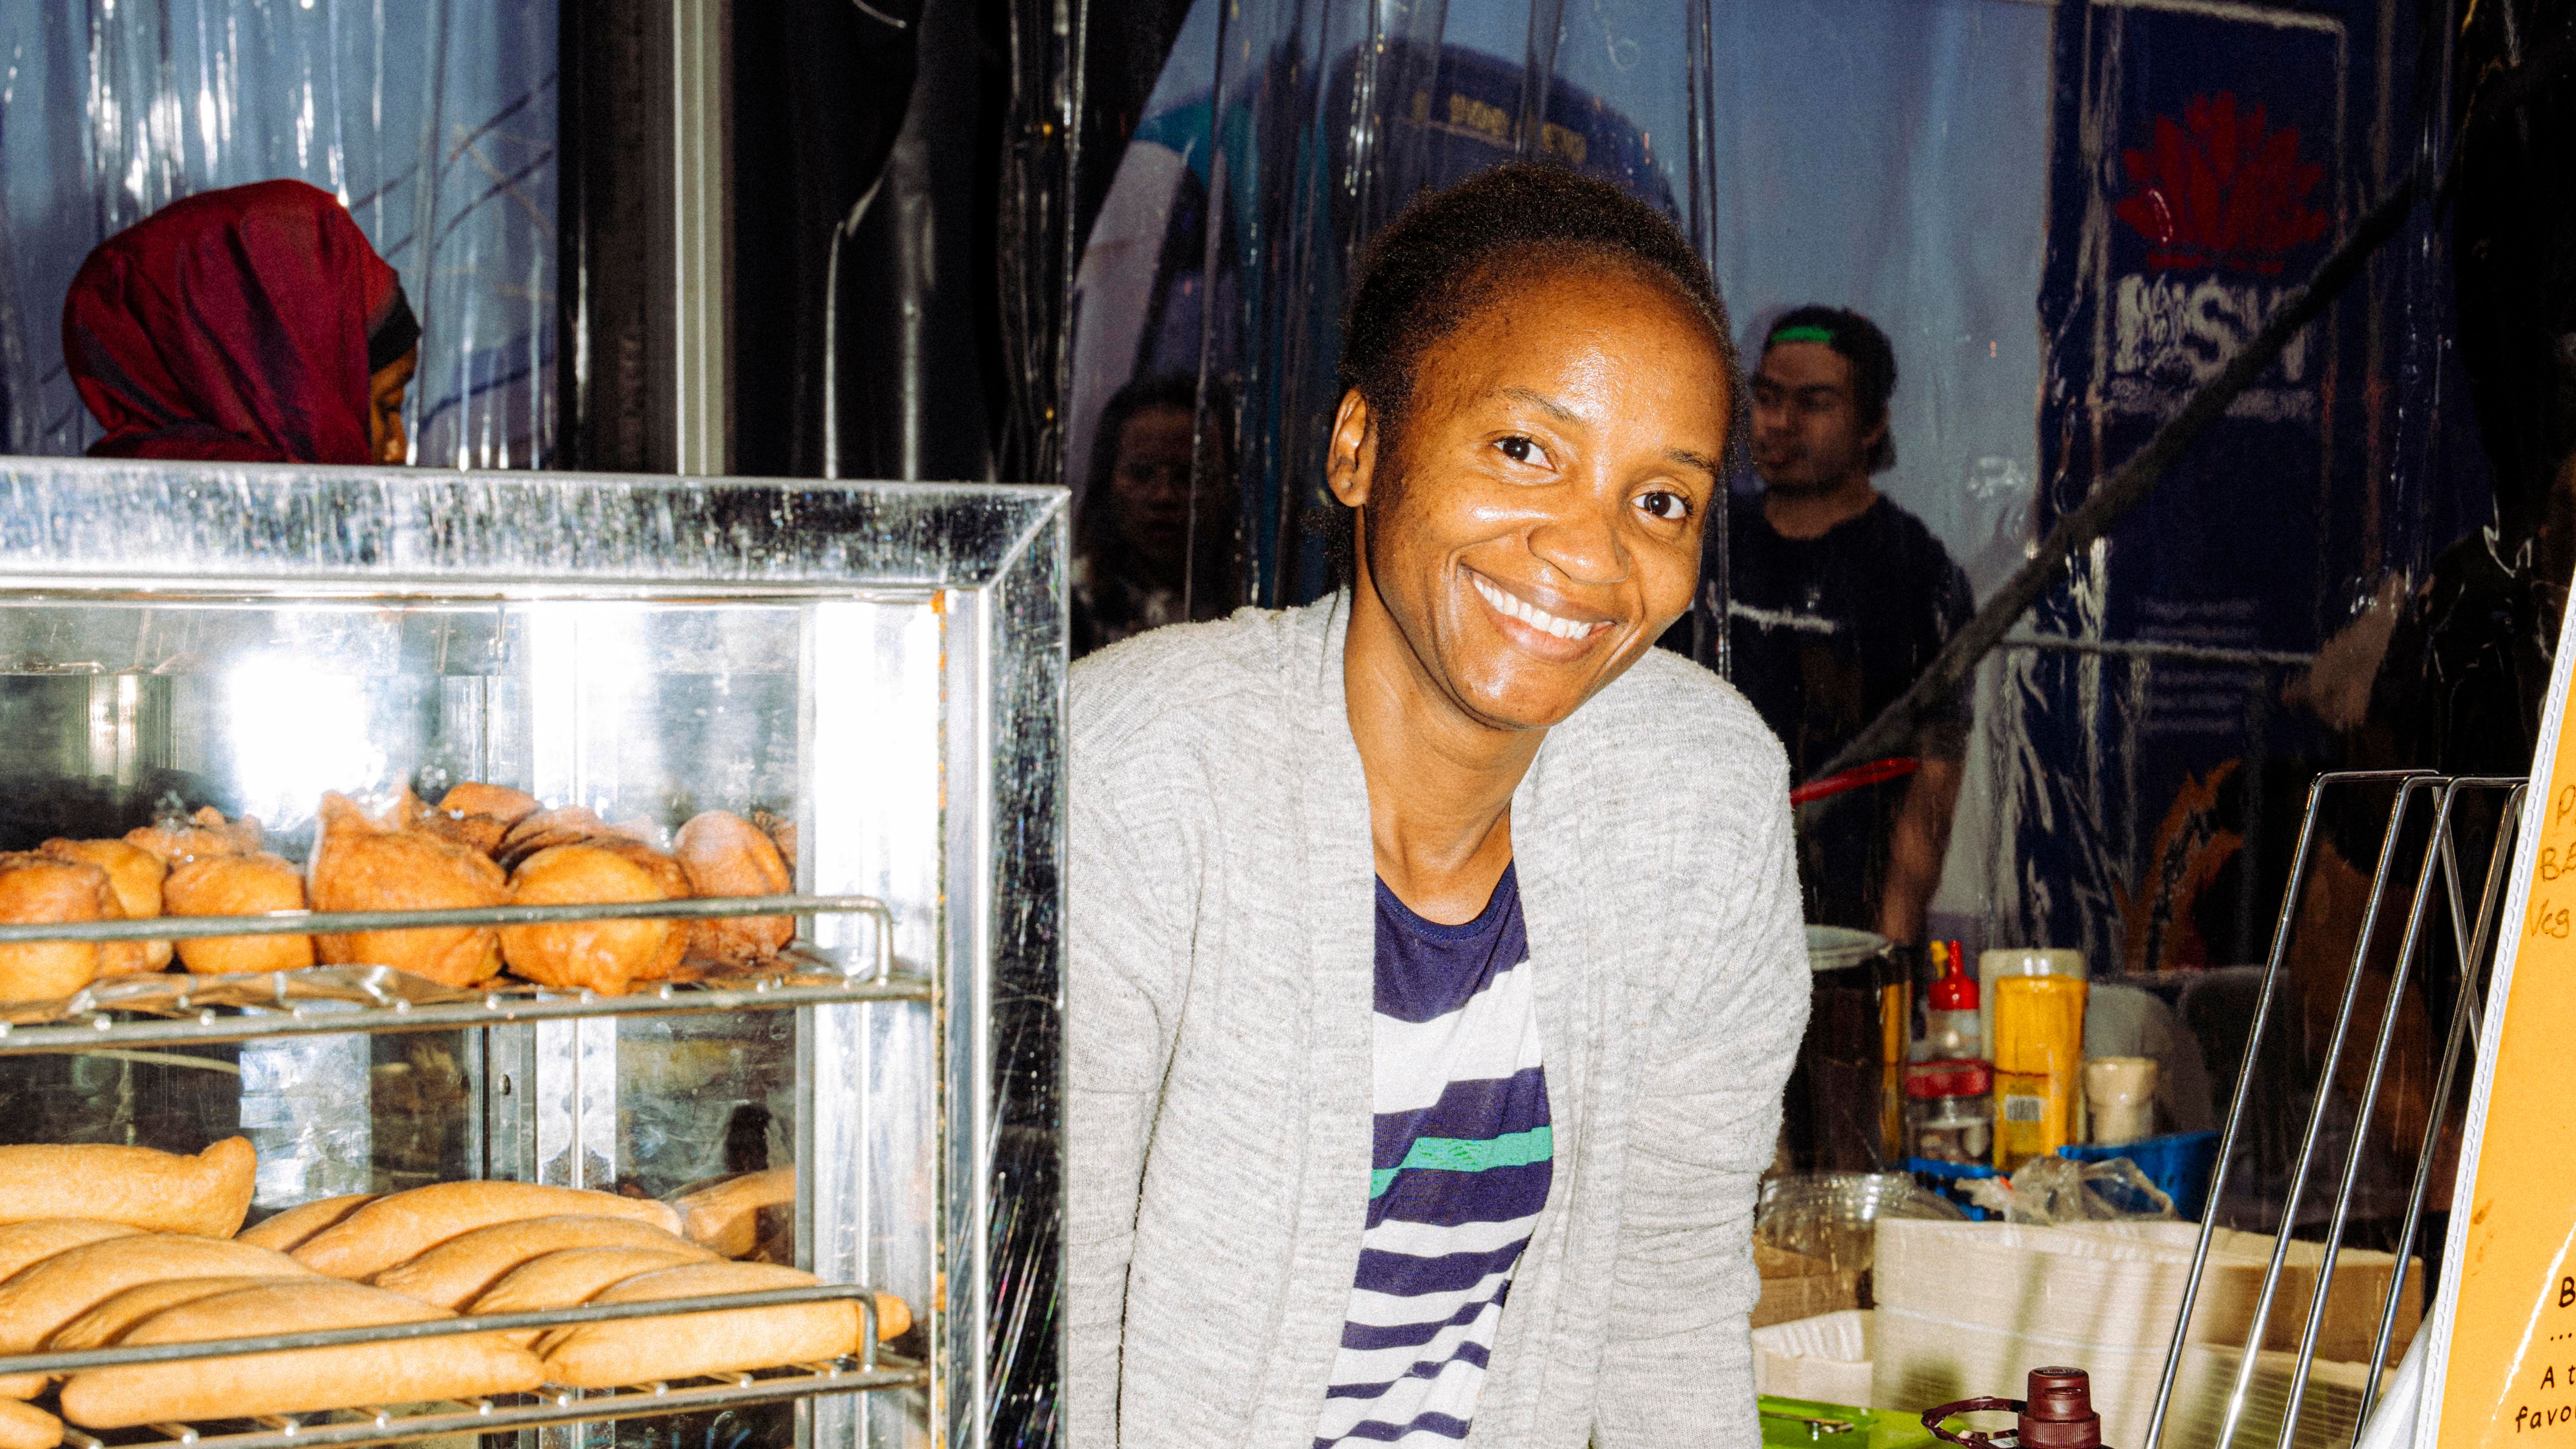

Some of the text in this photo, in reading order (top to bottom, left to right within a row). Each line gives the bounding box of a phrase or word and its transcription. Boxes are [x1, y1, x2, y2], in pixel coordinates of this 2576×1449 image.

[2530, 899, 2570, 939] Veg
[2540, 1366, 2555, 1390] A
[2515, 1406, 2576, 1434] favo
